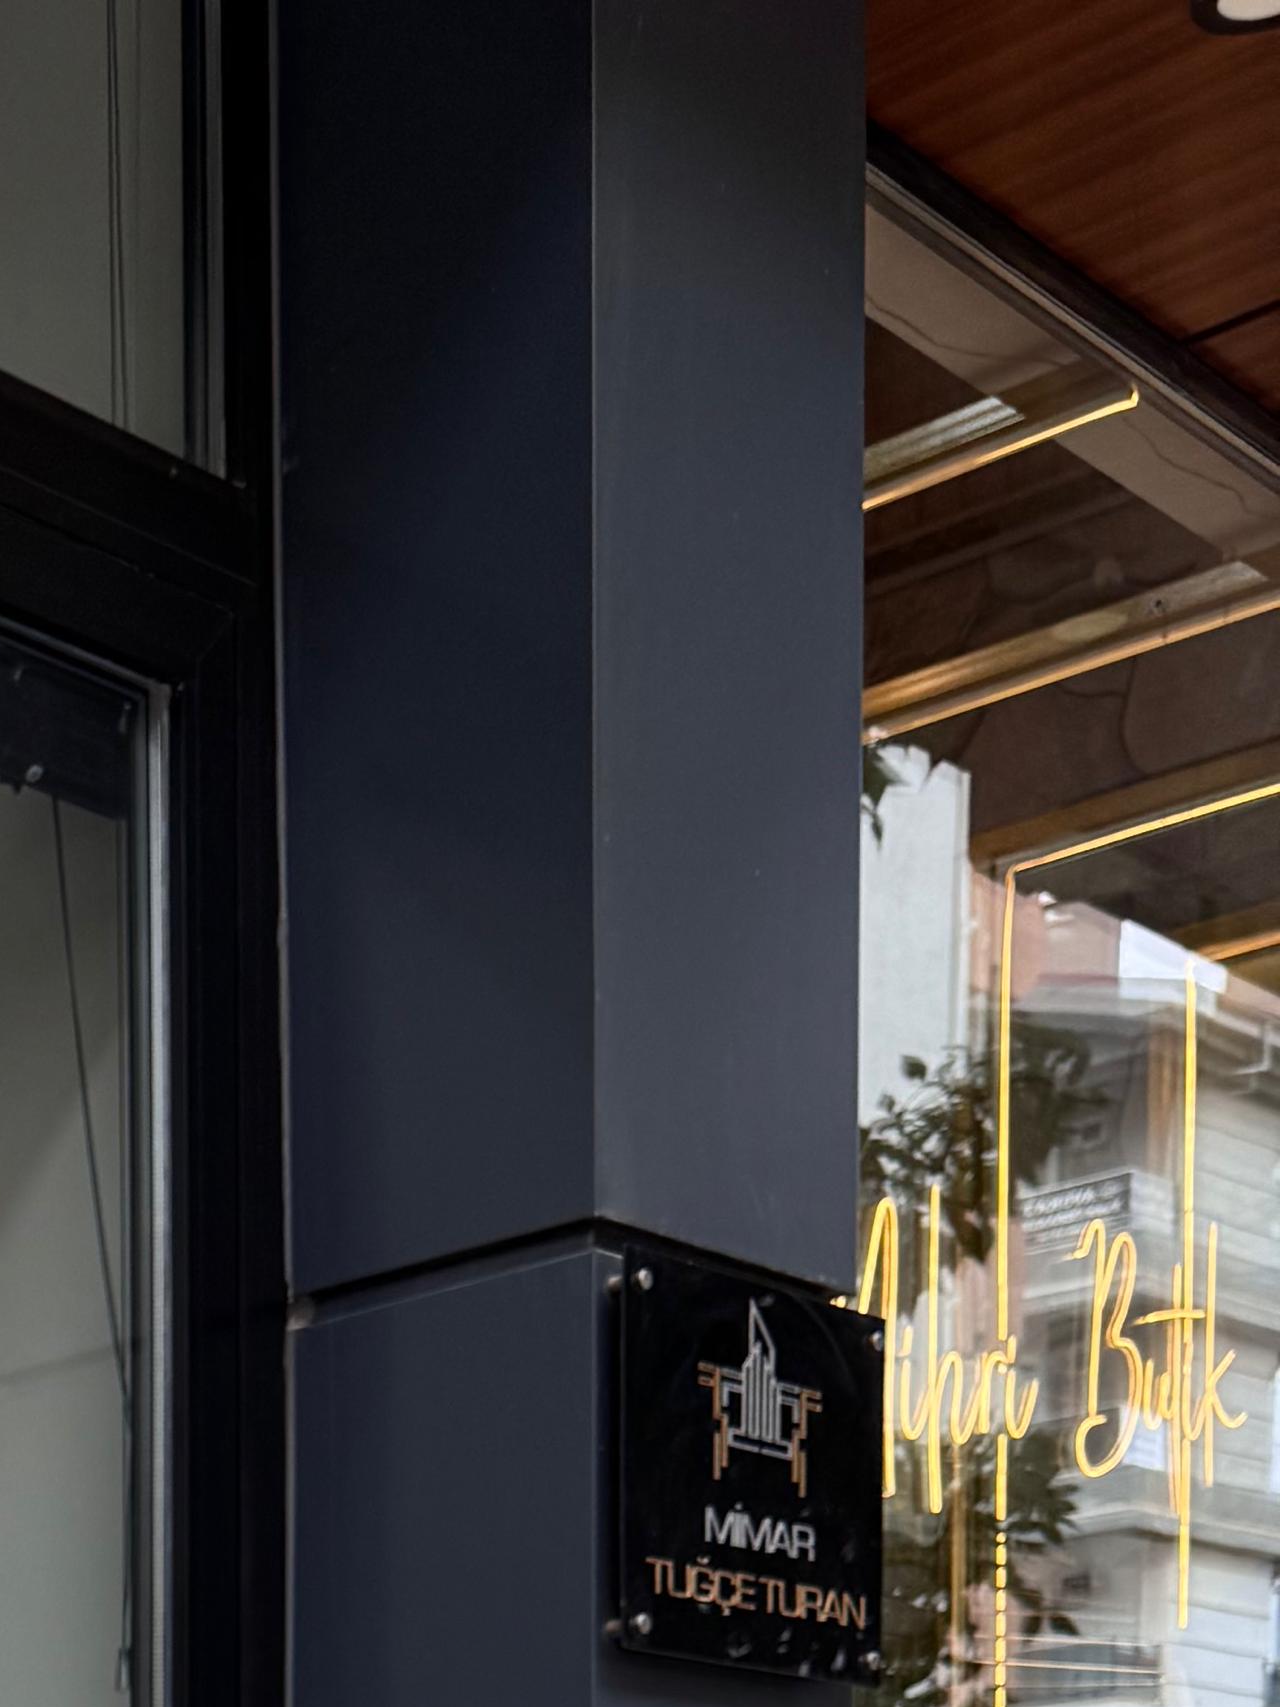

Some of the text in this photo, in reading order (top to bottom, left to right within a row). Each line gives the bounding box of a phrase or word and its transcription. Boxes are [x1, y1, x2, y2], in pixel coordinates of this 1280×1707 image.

[704, 1502, 816, 1562] MİMAR
[645, 1555, 866, 1631] TUĞÇE TURAN
